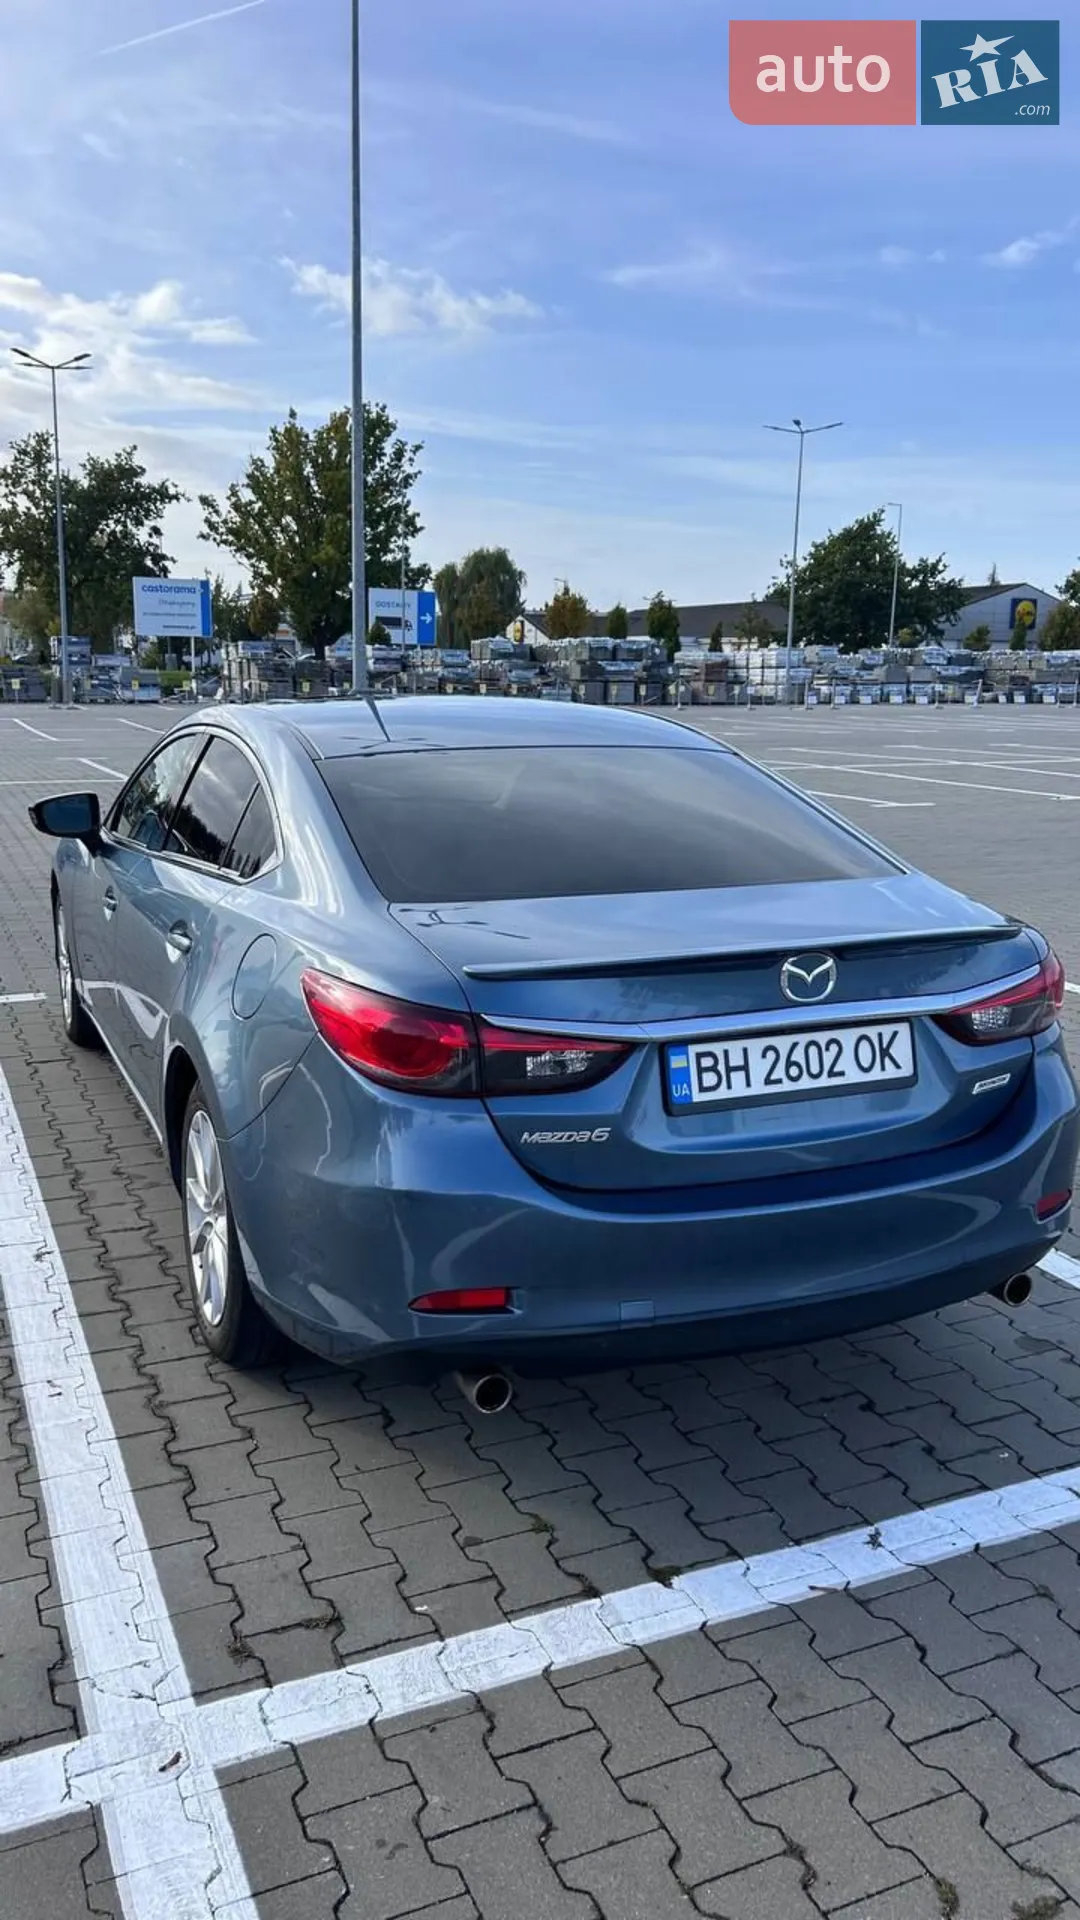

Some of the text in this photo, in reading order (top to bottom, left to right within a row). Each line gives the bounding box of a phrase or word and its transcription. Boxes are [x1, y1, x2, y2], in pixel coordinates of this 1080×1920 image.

[141, 584, 197, 594] castorama
[695, 1030, 902, 1094] BH 2602 OK
[672, 1083, 691, 1097] UA
